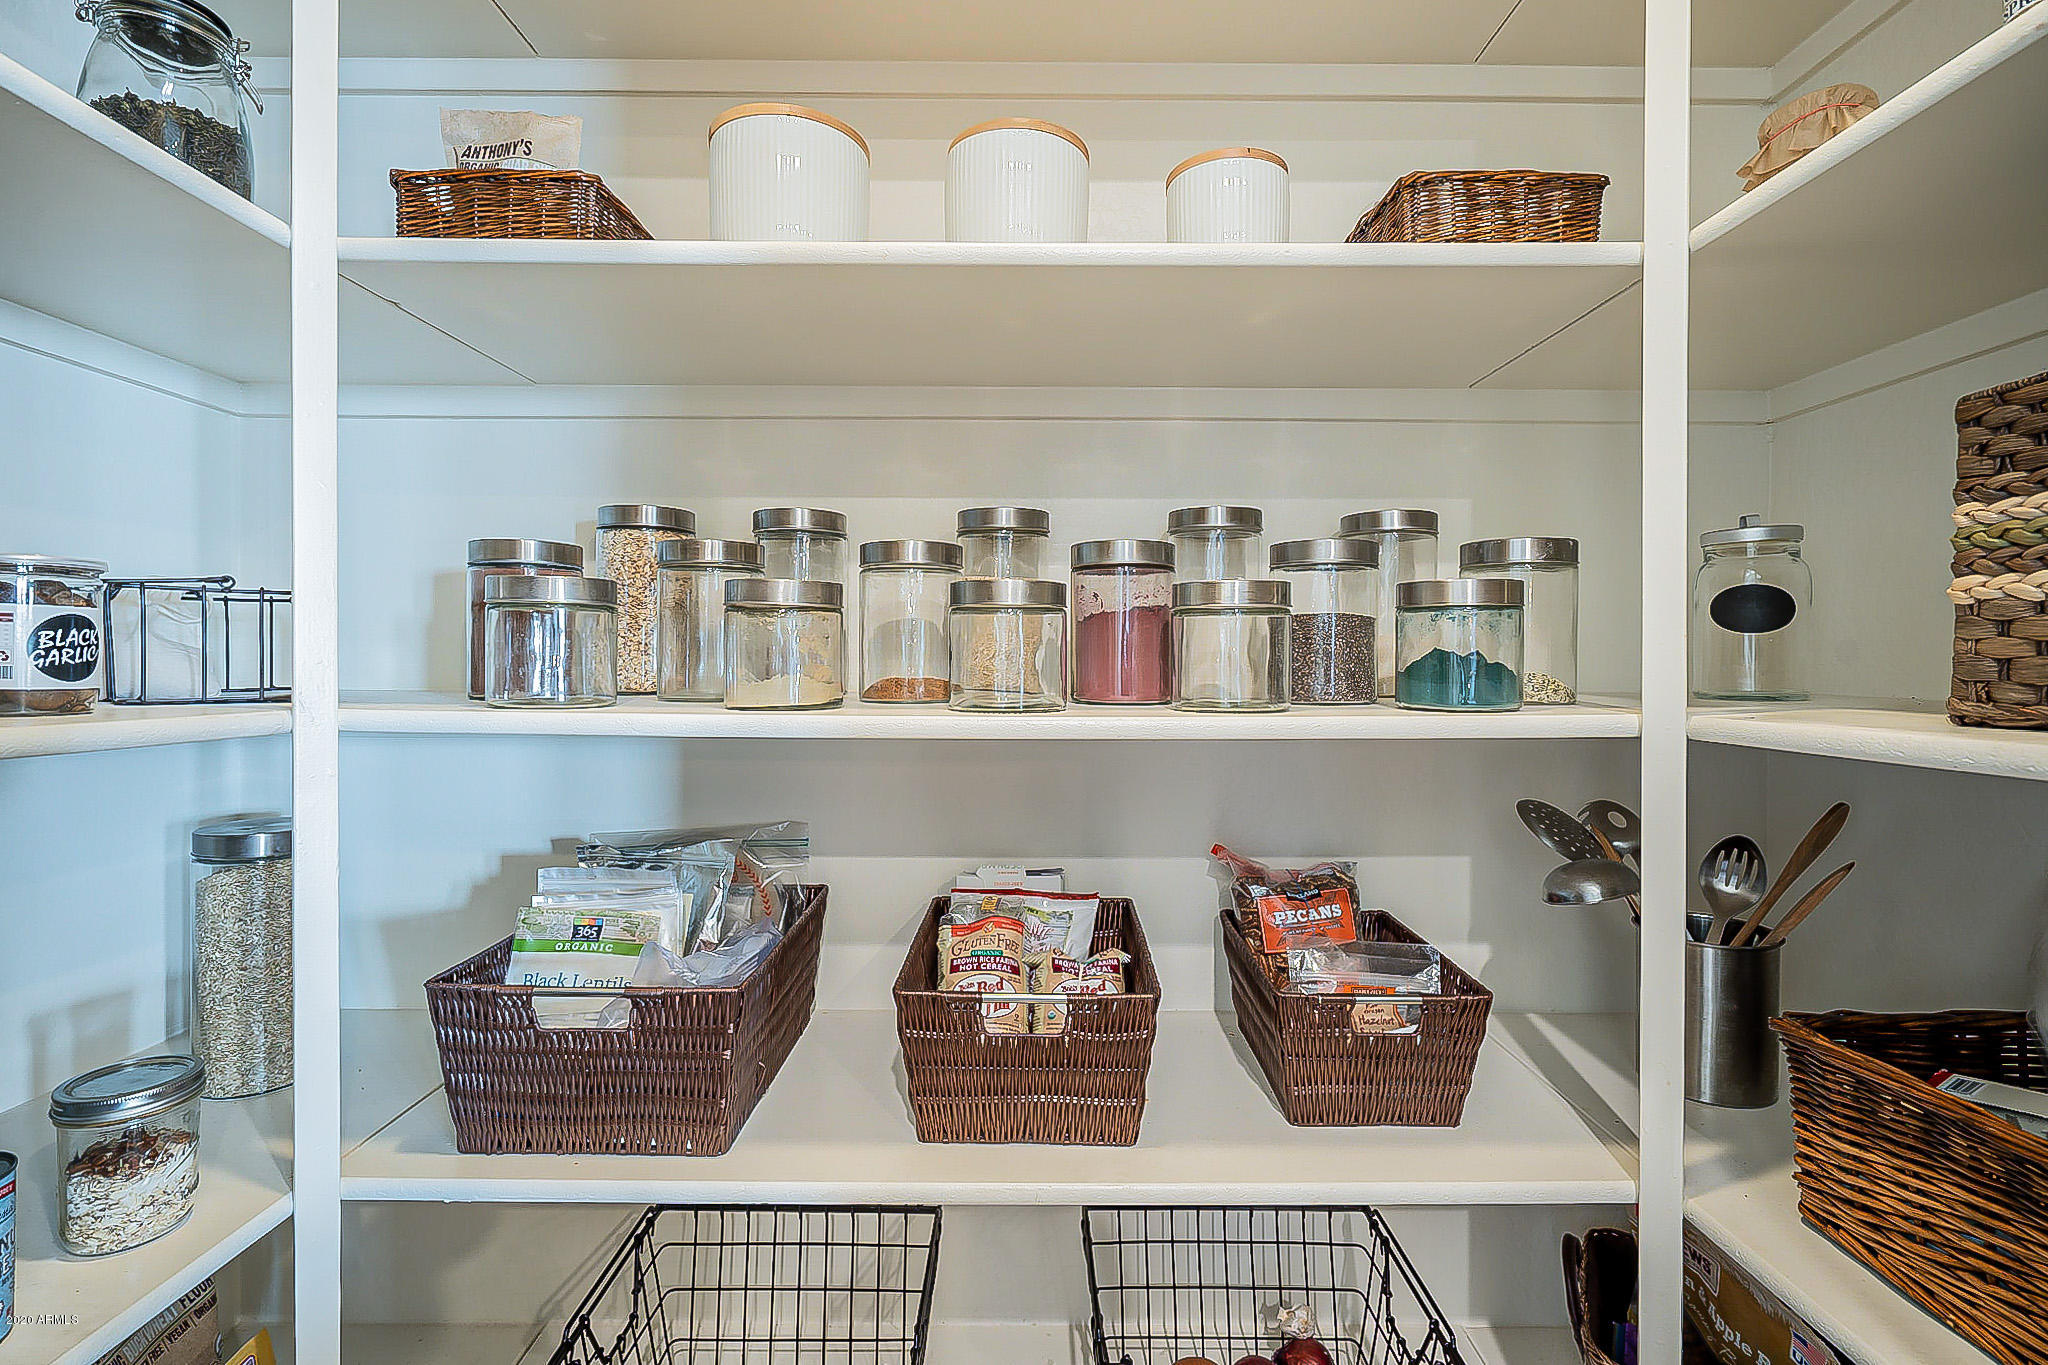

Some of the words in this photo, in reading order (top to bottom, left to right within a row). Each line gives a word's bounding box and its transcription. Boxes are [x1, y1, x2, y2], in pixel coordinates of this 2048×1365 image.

[461, 139, 532, 159] ANTHONY'S
[38, 628, 98, 649] BLACK
[29, 645, 99, 667] GARLIC
[1273, 903, 1342, 925] PECANS
[575, 926, 598, 938] 365
[555, 942, 614, 953] ORGANIC
[952, 937, 996, 957] GLUTEN
[996, 932, 1020, 955] FREE
[953, 957, 978, 966] BROWN
[979, 956, 995, 964] RICE
[960, 963, 978, 971] HOT
[980, 963, 1012, 972] CEREAL
[523, 972, 567, 987] Black
[573, 973, 632, 988] Lentils
[977, 977, 1004, 992] Red
[178, 1276, 214, 1311] FLOUR
[166, 1318, 190, 1345] VEGAN
[1708, 1301, 1753, 1357] Apple
